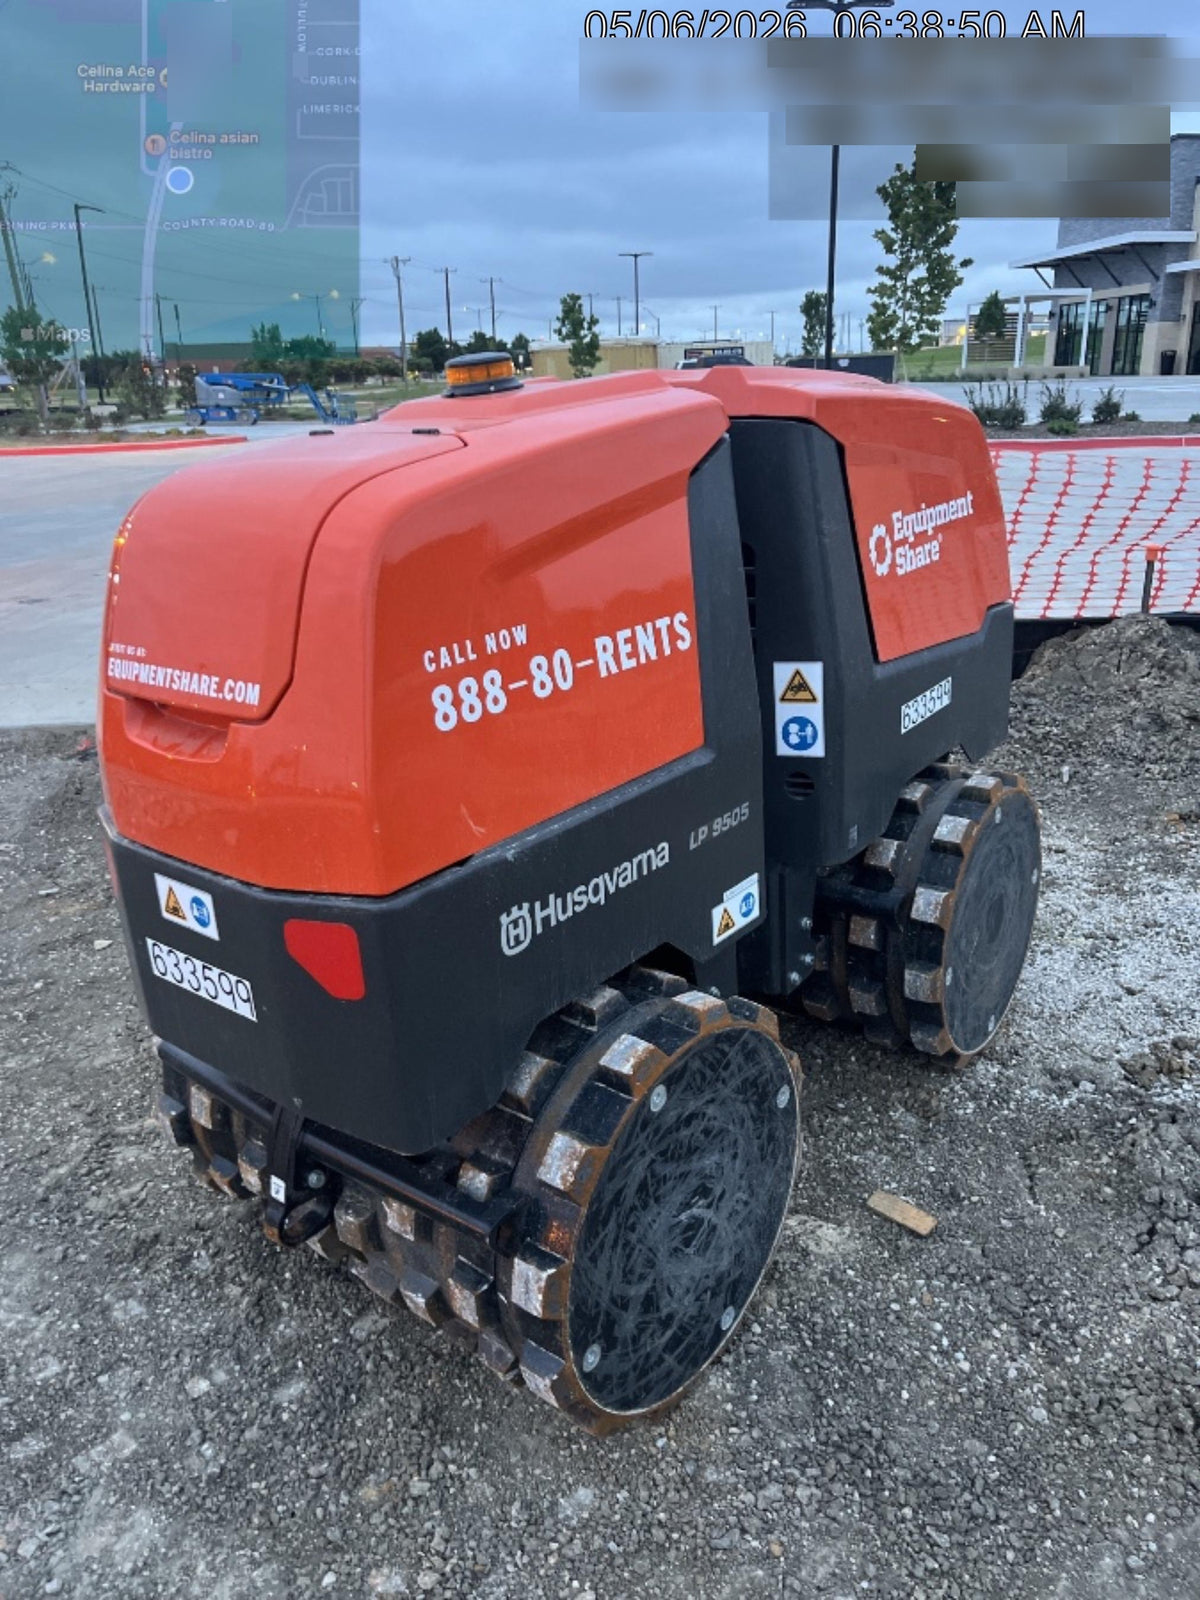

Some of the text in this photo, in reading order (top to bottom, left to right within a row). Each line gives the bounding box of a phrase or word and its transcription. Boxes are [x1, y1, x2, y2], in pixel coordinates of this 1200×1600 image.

[892, 490, 974, 543] Equipment
[895, 542, 940, 576] Share
[423, 623, 528, 673] CALL NOW
[431, 611, 692, 732] 888-80-RENTS
[107, 657, 260, 706] EQUIPMENTSHARE.COM
[689, 802, 750, 850] LP 9505
[534, 841, 671, 935] Husqvarna
[151, 942, 257, 1019] 633599
